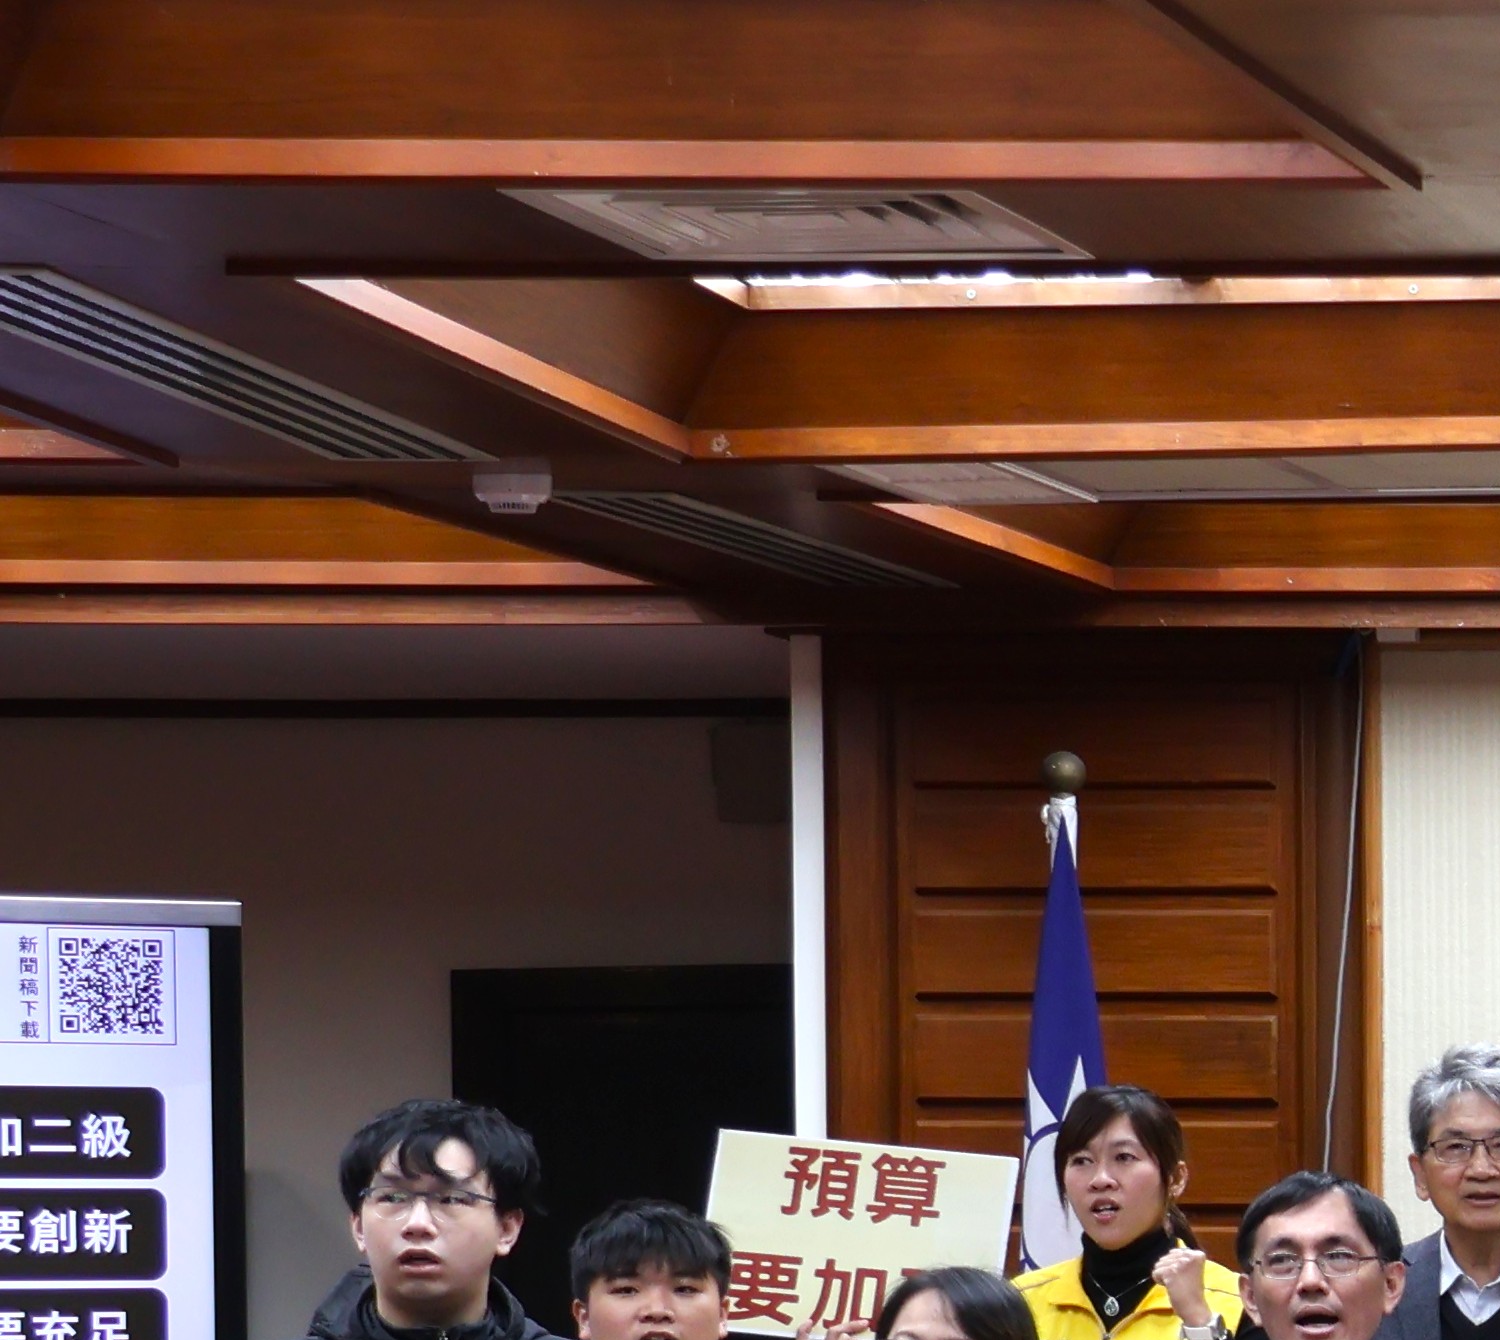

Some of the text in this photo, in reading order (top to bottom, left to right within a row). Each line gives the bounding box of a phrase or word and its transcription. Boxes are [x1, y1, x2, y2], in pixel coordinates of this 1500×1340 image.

[18, 935, 39, 1038] 新聞稿下載
[781, 1146, 947, 1227] 預算
[727, 1251, 923, 1332] 要加
